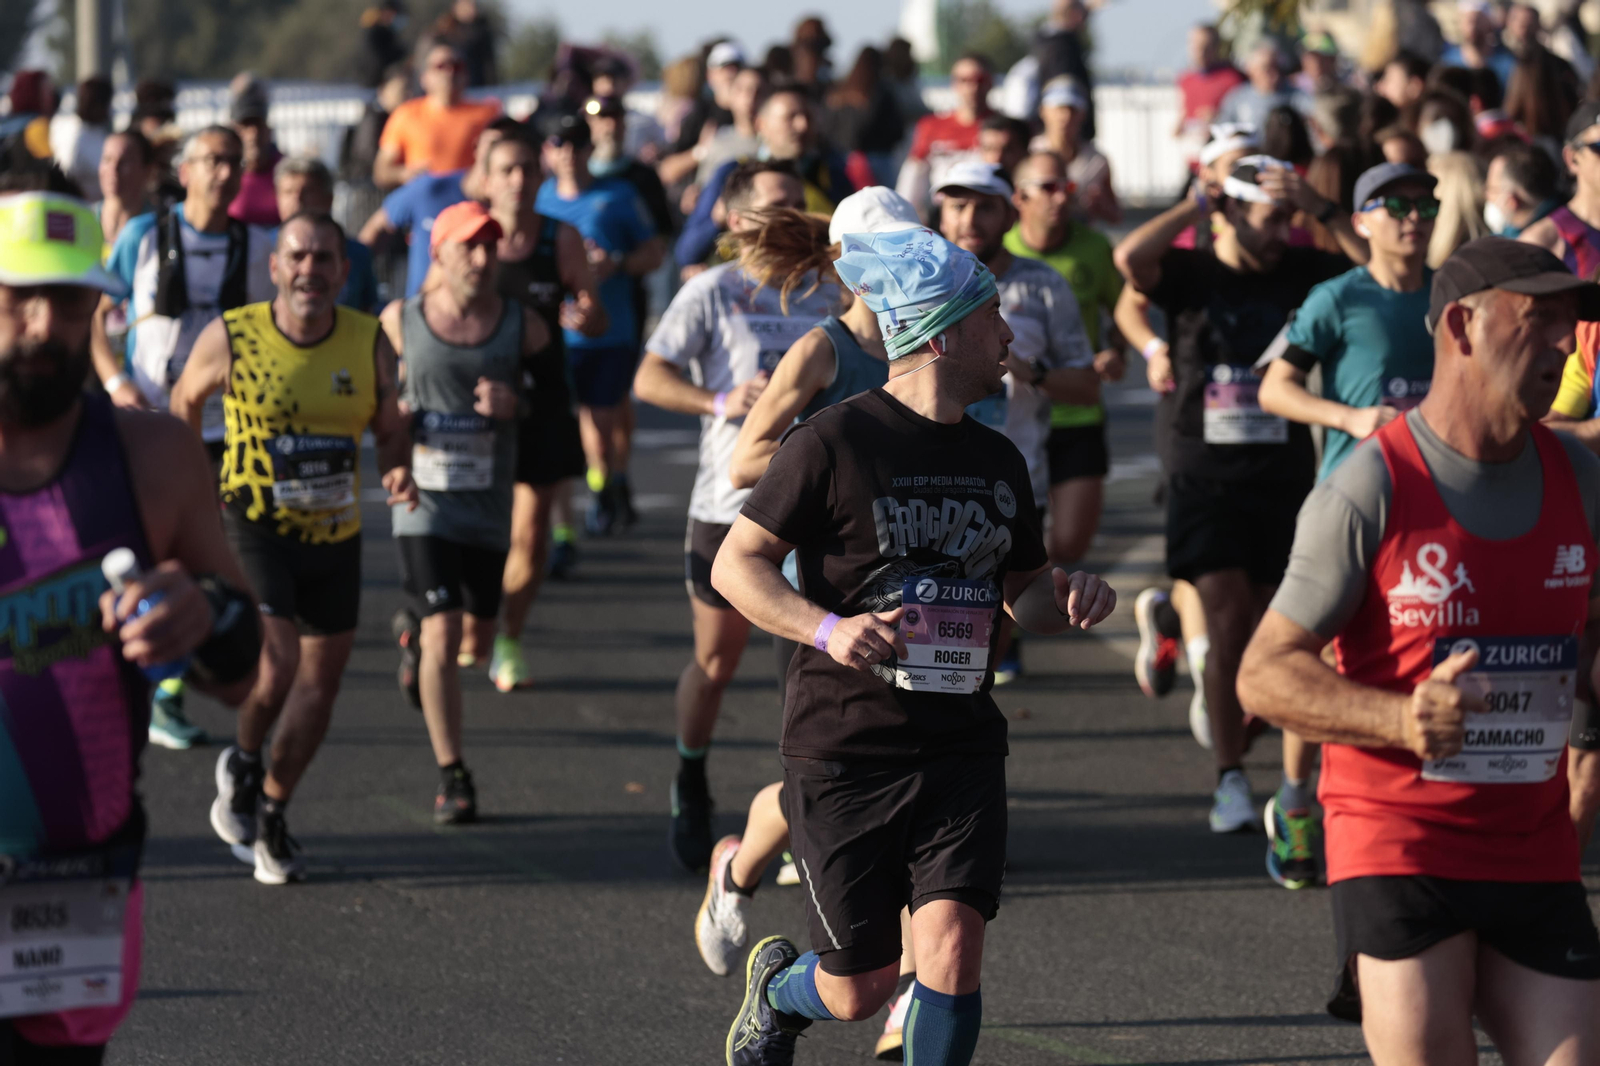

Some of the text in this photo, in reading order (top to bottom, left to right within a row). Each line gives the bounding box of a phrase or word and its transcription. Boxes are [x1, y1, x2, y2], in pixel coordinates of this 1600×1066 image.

[892, 477, 911, 488] XXIII
[914, 476, 928, 486] EDP
[930, 476, 952, 486] MEDIA
[954, 475, 986, 487] MARATÓN
[913, 486, 933, 494] Ciudad
[934, 486, 941, 494] de
[942, 486, 966, 495] Zaragoza
[940, 585, 991, 602] ZURICH
[1388, 600, 1480, 628] Sevilla
[938, 620, 974, 639] 6569
[934, 649, 972, 665] ROGER
[1484, 644, 1563, 665] ZURICH
[1464, 728, 1545, 747] CAMACHO
[13, 945, 63, 969] NANO
